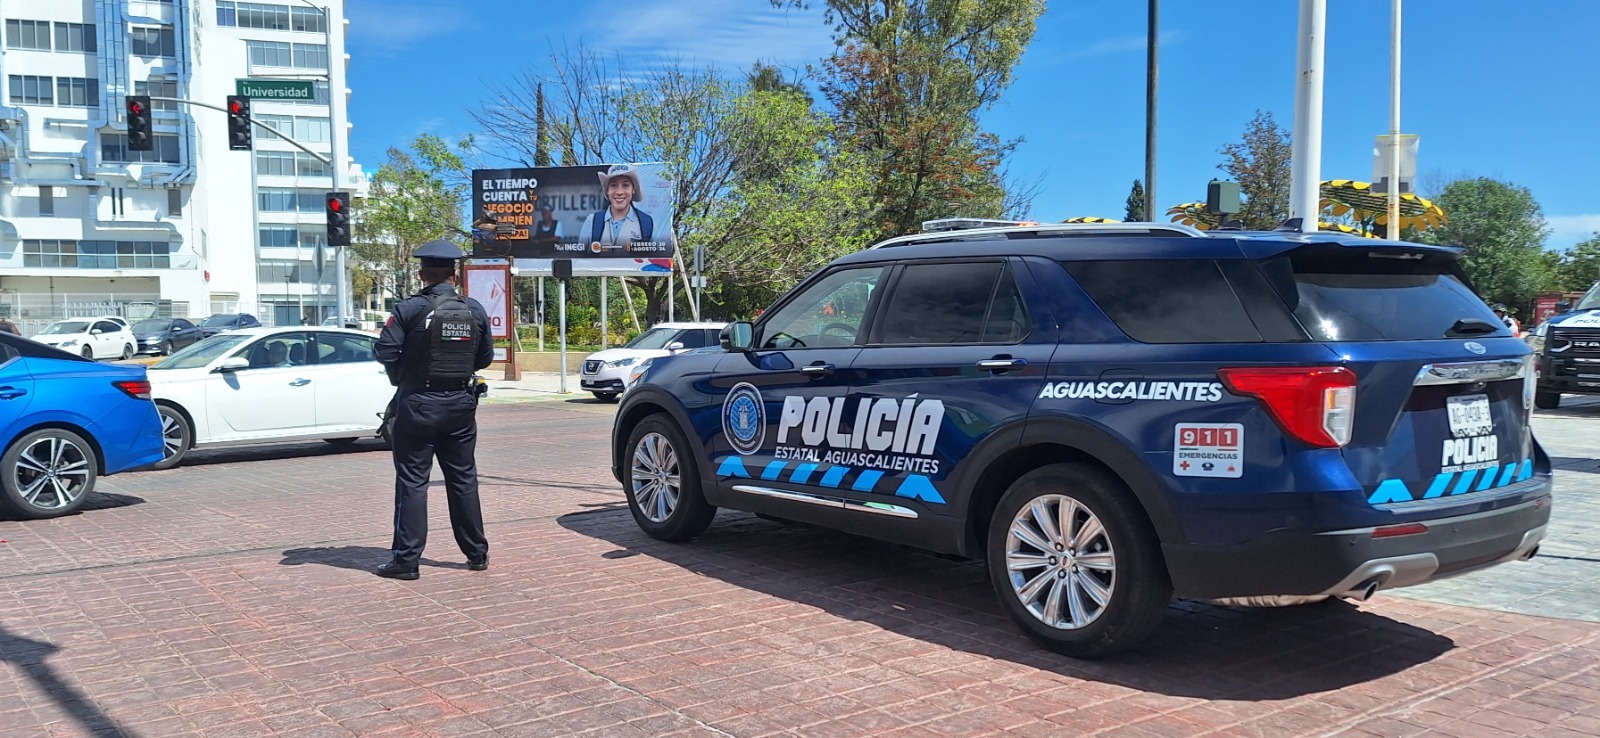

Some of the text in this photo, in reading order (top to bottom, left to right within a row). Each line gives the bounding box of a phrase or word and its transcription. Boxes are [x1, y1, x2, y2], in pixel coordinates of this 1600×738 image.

[243, 86, 308, 97] Universidad
[482, 178, 538, 190] EL TIEMPO
[482, 190, 528, 202] CUENTA
[564, 243, 585, 251] INEGI
[442, 322, 471, 331] POLICÍA
[441, 329, 471, 337] ESTATAL
[1039, 382, 1223, 402] AGUASCALIENTES
[776, 392, 946, 455] POLICÍA
[774, 446, 940, 474] ESTATAL AGUASCALIENTES
[1178, 452, 1238, 460] EMERGENCIAS
